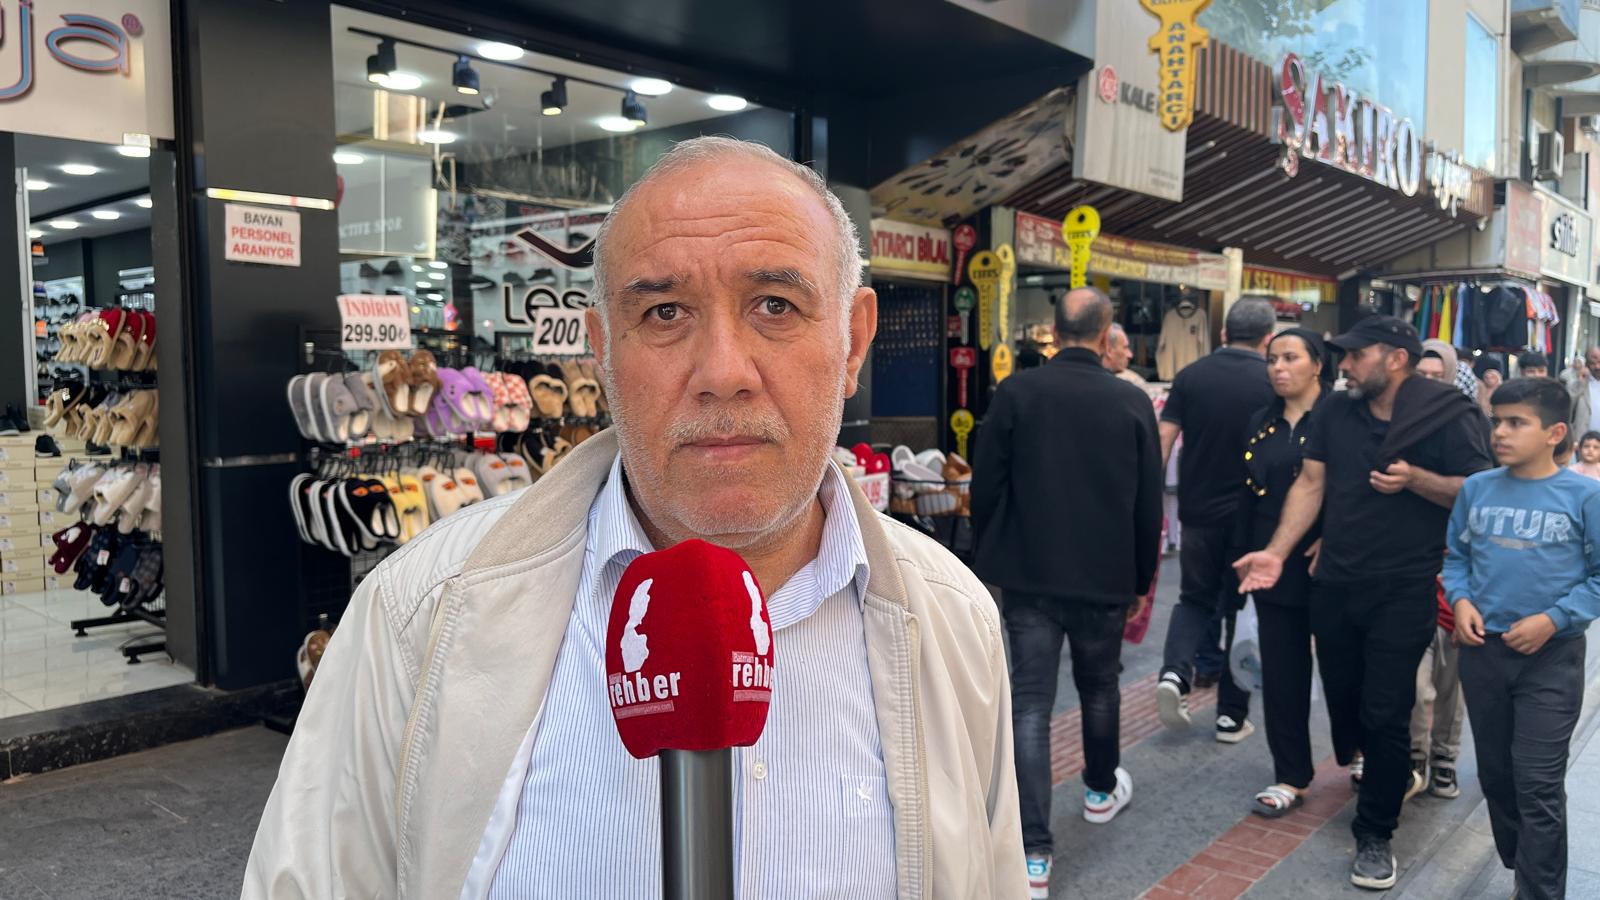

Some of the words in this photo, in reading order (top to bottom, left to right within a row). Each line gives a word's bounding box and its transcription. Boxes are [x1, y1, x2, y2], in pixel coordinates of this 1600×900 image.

[1121, 81, 1156, 113] KALE
[244, 212, 283, 227] BAYAN
[231, 225, 295, 245] PERSONEL
[232, 243, 294, 260] ARANIYOR
[537, 317, 580, 346] 200
[609, 671, 681, 708] rehber
